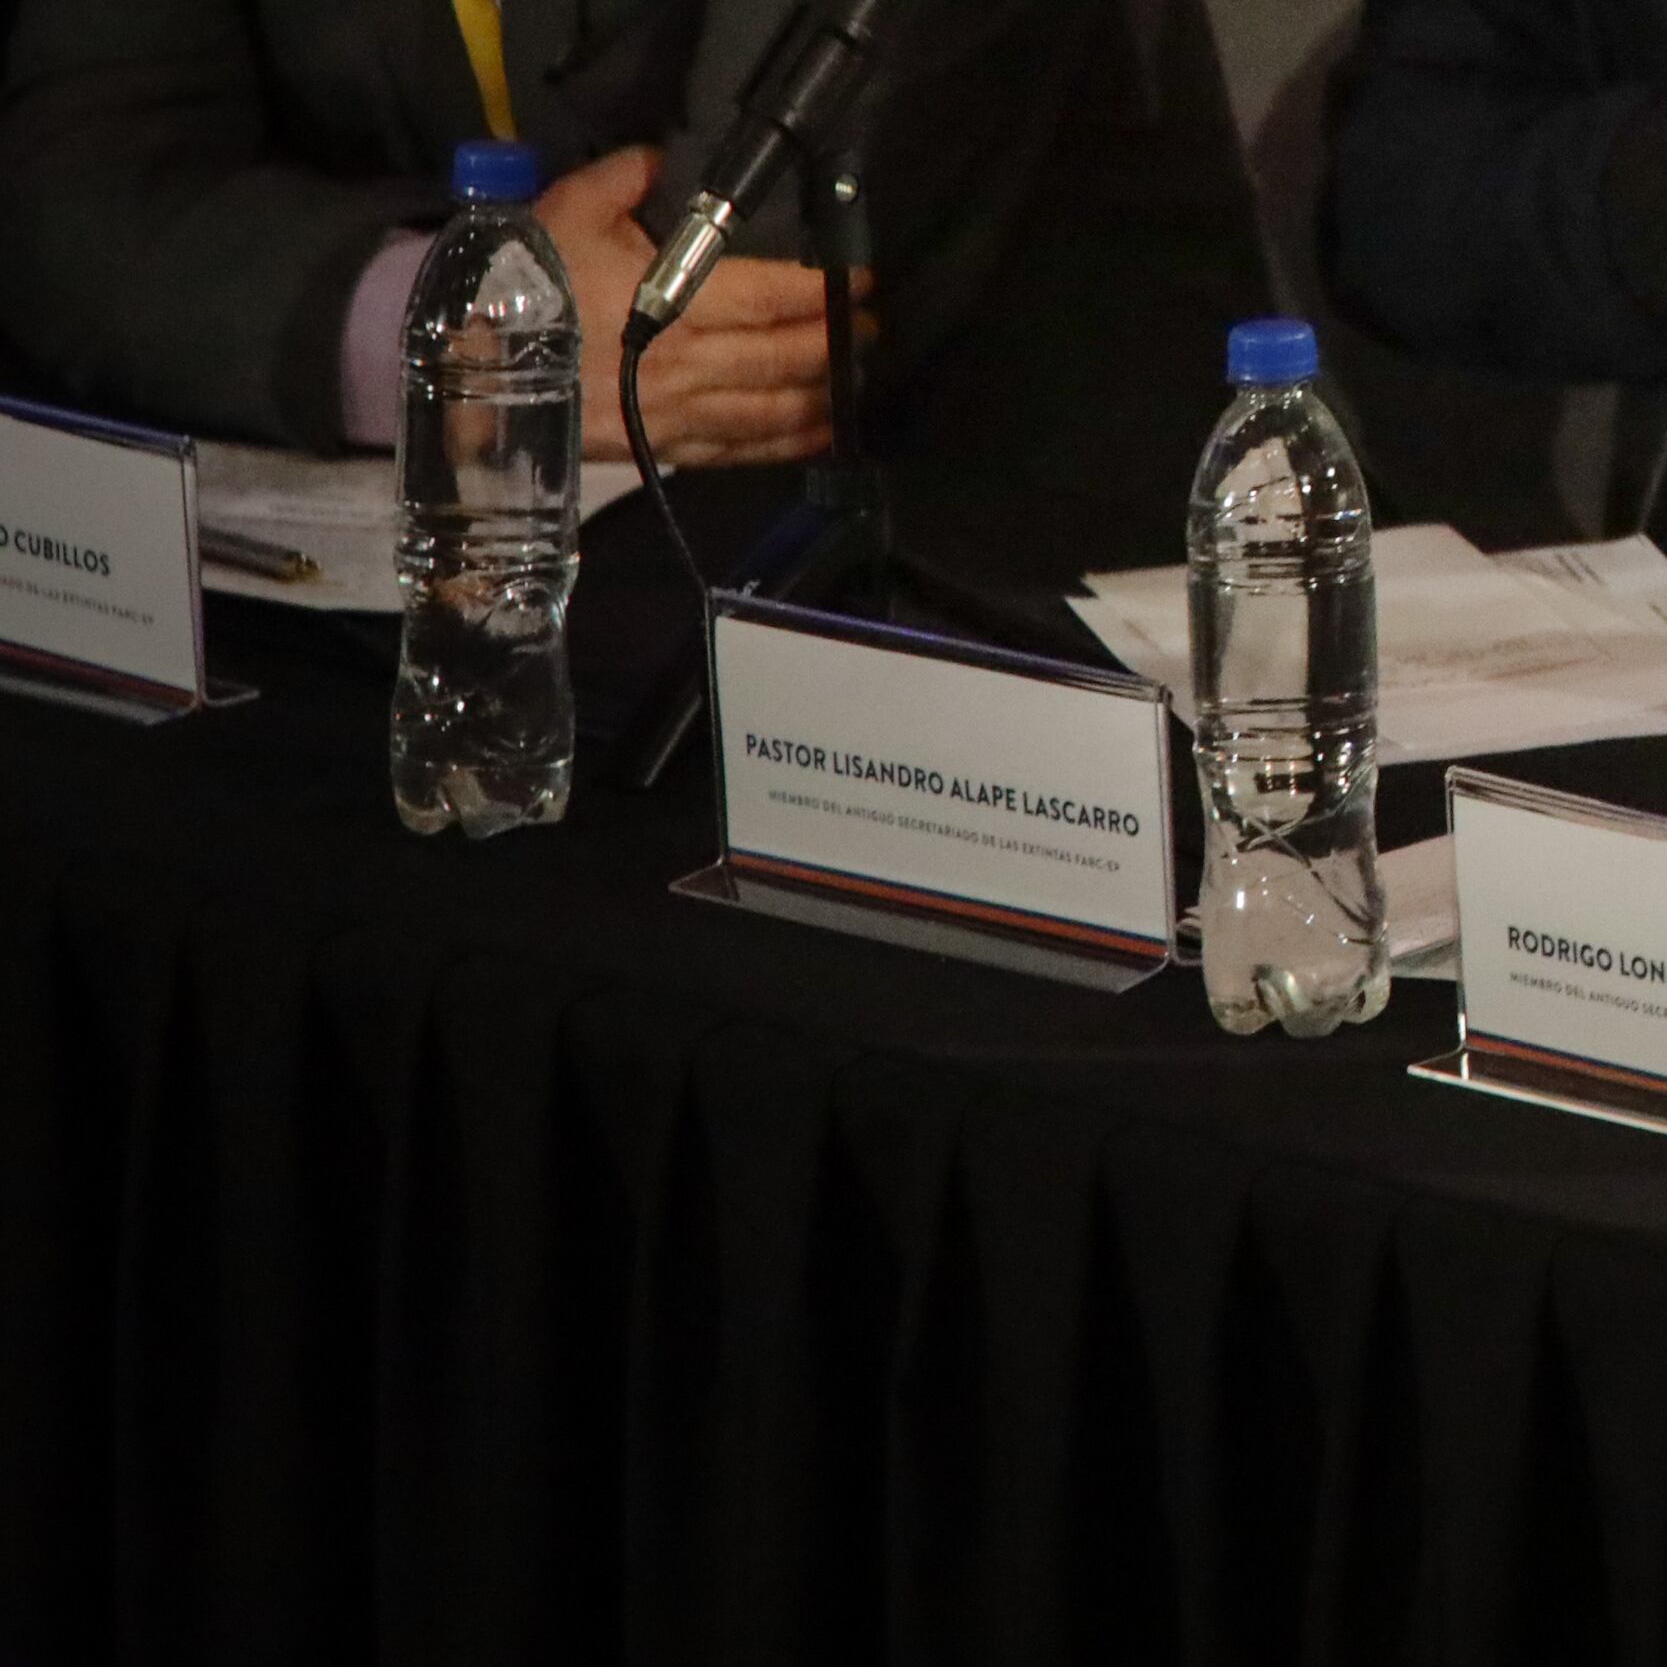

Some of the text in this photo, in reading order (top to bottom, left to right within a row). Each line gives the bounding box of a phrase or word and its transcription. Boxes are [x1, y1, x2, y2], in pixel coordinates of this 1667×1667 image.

[13, 530, 111, 576] CUBILLOS
[745, 734, 1141, 836] PASTOR LISANDRO ALAPE LASCARRO
[768, 790, 820, 809] MIEMBRO
[822, 800, 843, 815] DEL
[846, 806, 894, 825] ANTIGUO
[897, 816, 979, 845] SECRETARIADO
[981, 834, 996, 848] DE
[1000, 838, 1018, 852] LAS
[1507, 926, 1614, 971] RODRIGO
[1509, 972, 1562, 993] MIEMBRO
[1565, 985, 1585, 1000] DEL
[1588, 992, 1639, 1012] ANTIGUO
